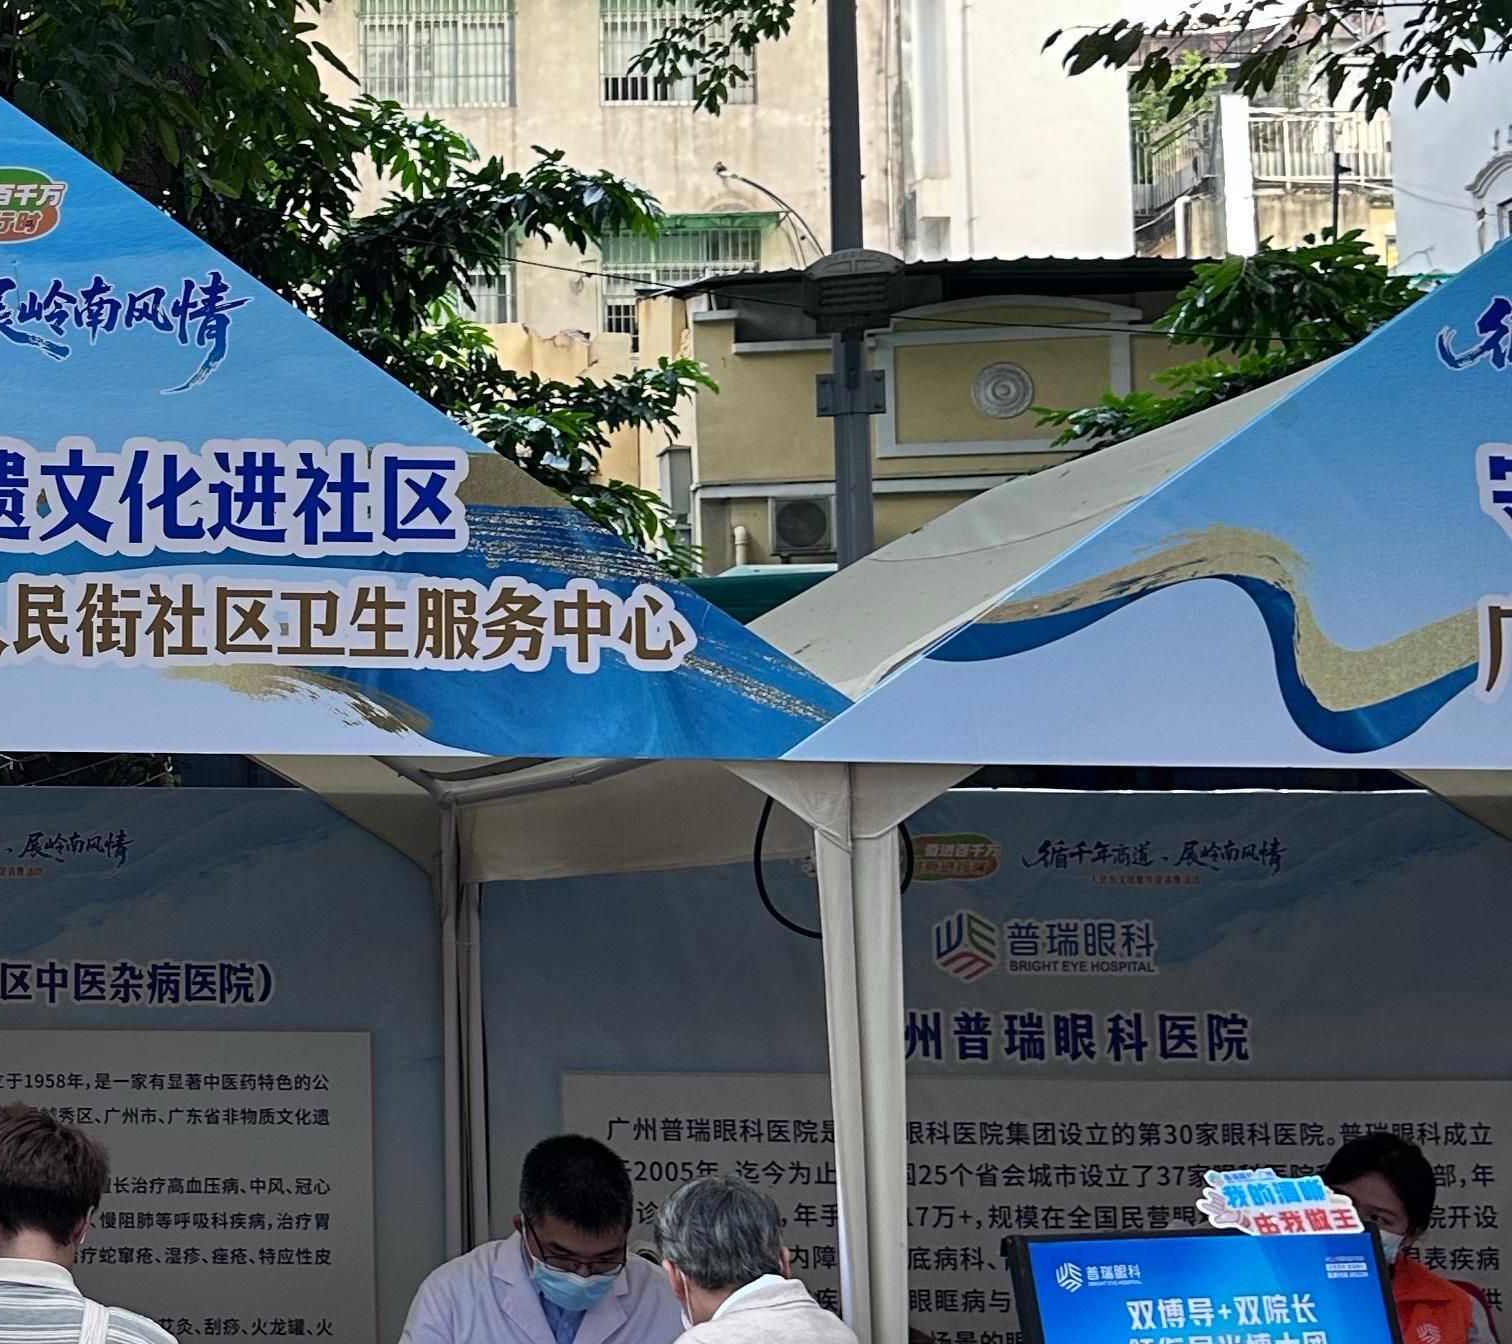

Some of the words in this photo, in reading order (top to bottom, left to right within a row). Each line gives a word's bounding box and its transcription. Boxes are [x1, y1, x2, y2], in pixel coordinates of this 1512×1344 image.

[1006, 921, 1156, 958] 普瑞眼科
[1009, 960, 1060, 973] BRIGHT
[1062, 960, 1088, 973] EYE
[1090, 960, 1155, 974] HOSPITAL
[904, 1012, 1251, 1062] 州普瑞眼科医院
[1254, 1208, 1359, 1236] 由我做主
[908, 1247, 1009, 1272] 底病科、
[1086, 1264, 1141, 1281] 普瑞眼科
[1126, 1293, 1318, 1331] 双博导+双院长
